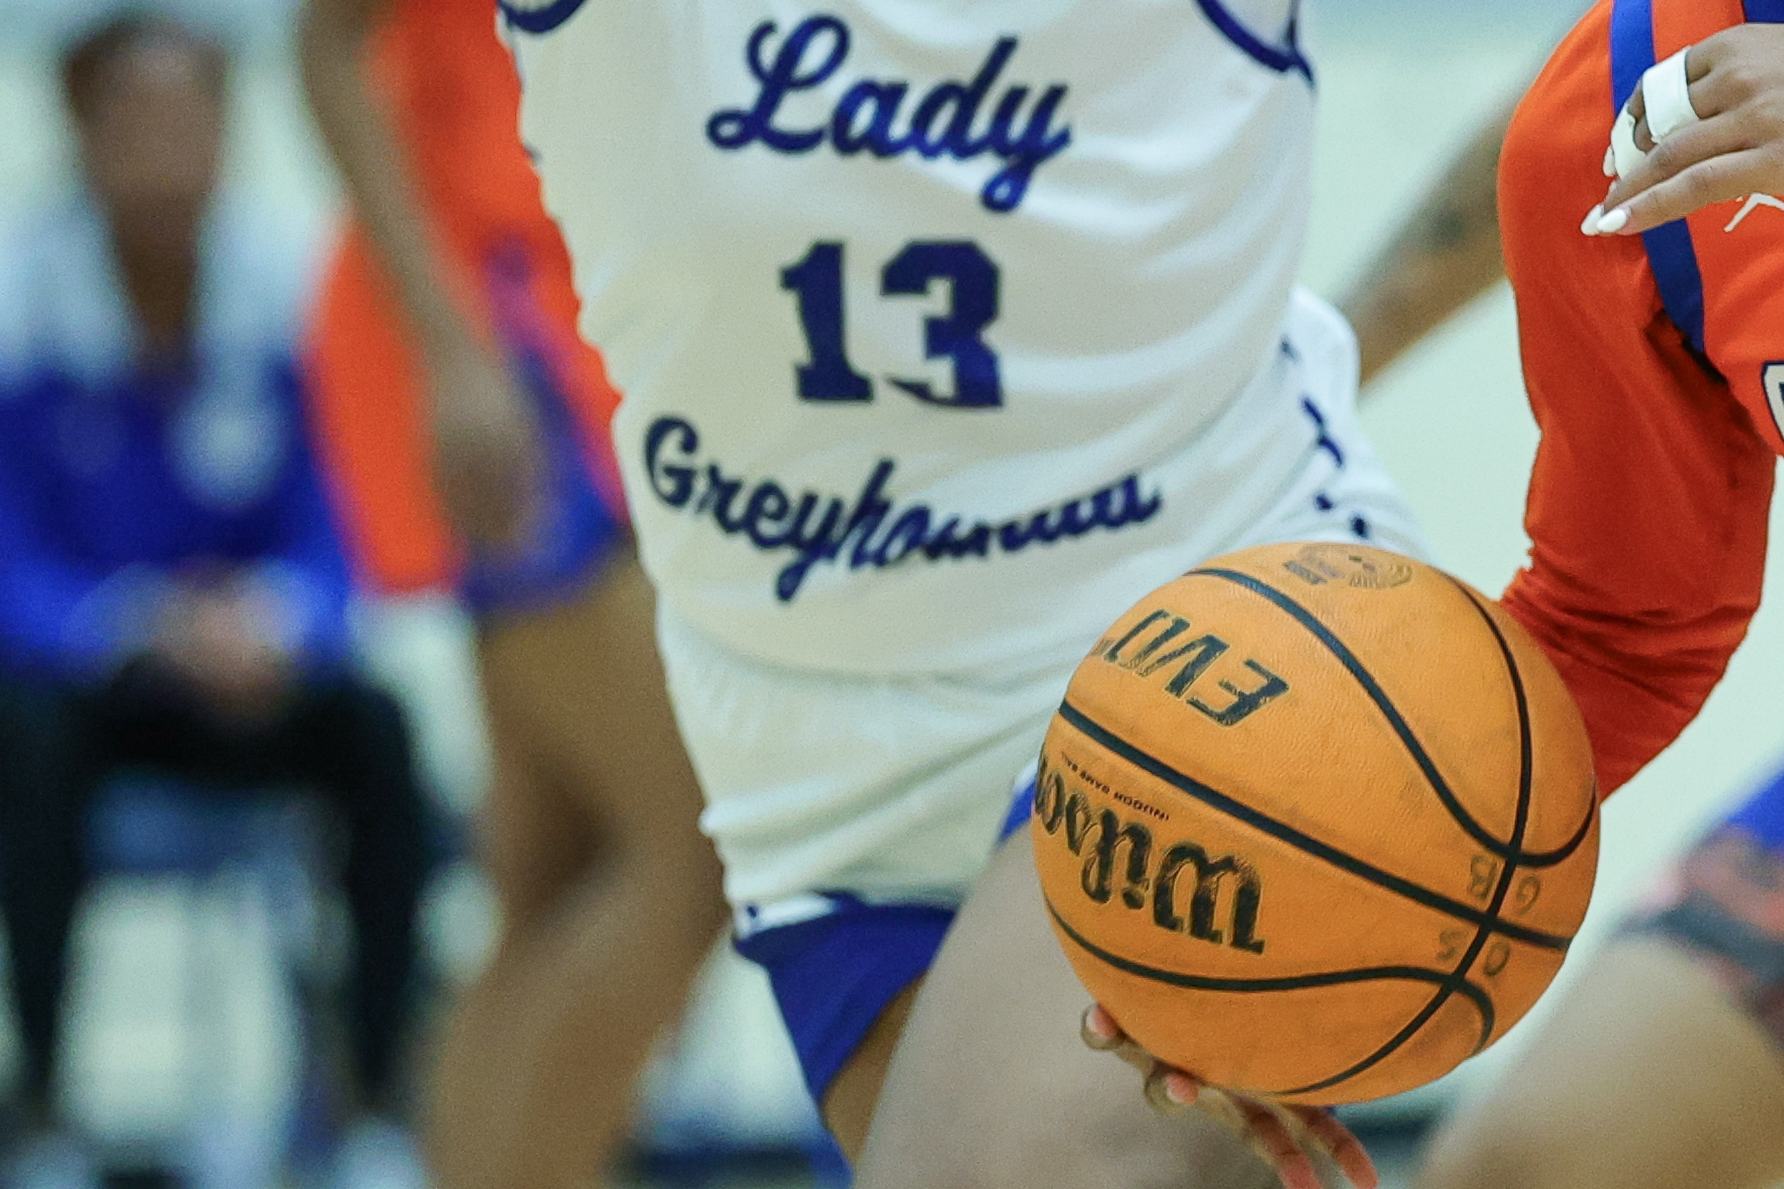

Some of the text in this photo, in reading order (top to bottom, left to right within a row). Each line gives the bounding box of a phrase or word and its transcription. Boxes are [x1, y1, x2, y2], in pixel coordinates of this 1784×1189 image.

[706, 14, 1073, 213] Lady
[779, 240, 1004, 409] 13
[1102, 608, 1291, 727] EVO
